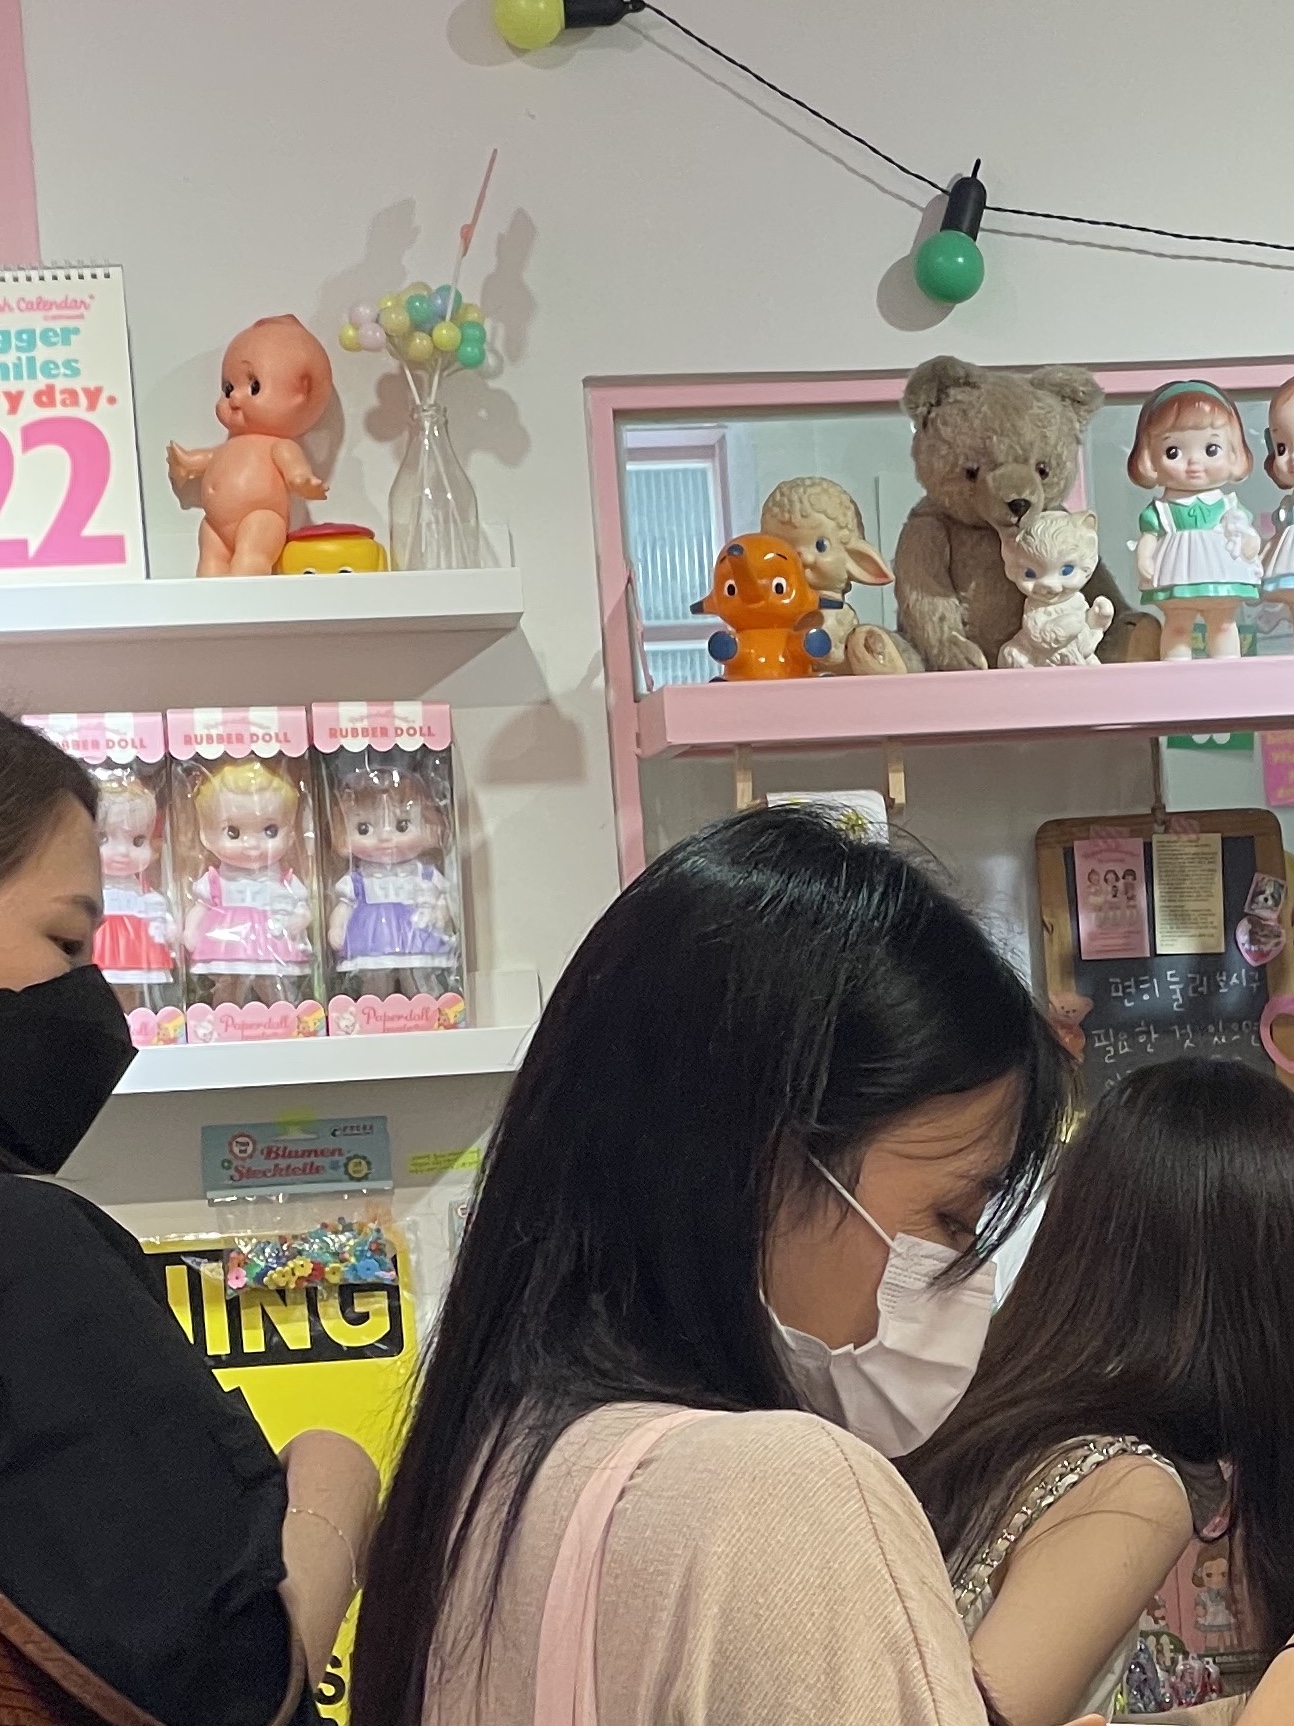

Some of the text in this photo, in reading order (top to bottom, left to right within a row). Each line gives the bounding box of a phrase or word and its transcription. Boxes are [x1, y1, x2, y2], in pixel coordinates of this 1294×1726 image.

[33, 383, 117, 412] day.
[0, 416, 126, 568] 2
[183, 731, 291, 746] RUBBER DOLL
[328, 724, 436, 739] RUBBER DOLL
[106, 737, 147, 749] DOLL
